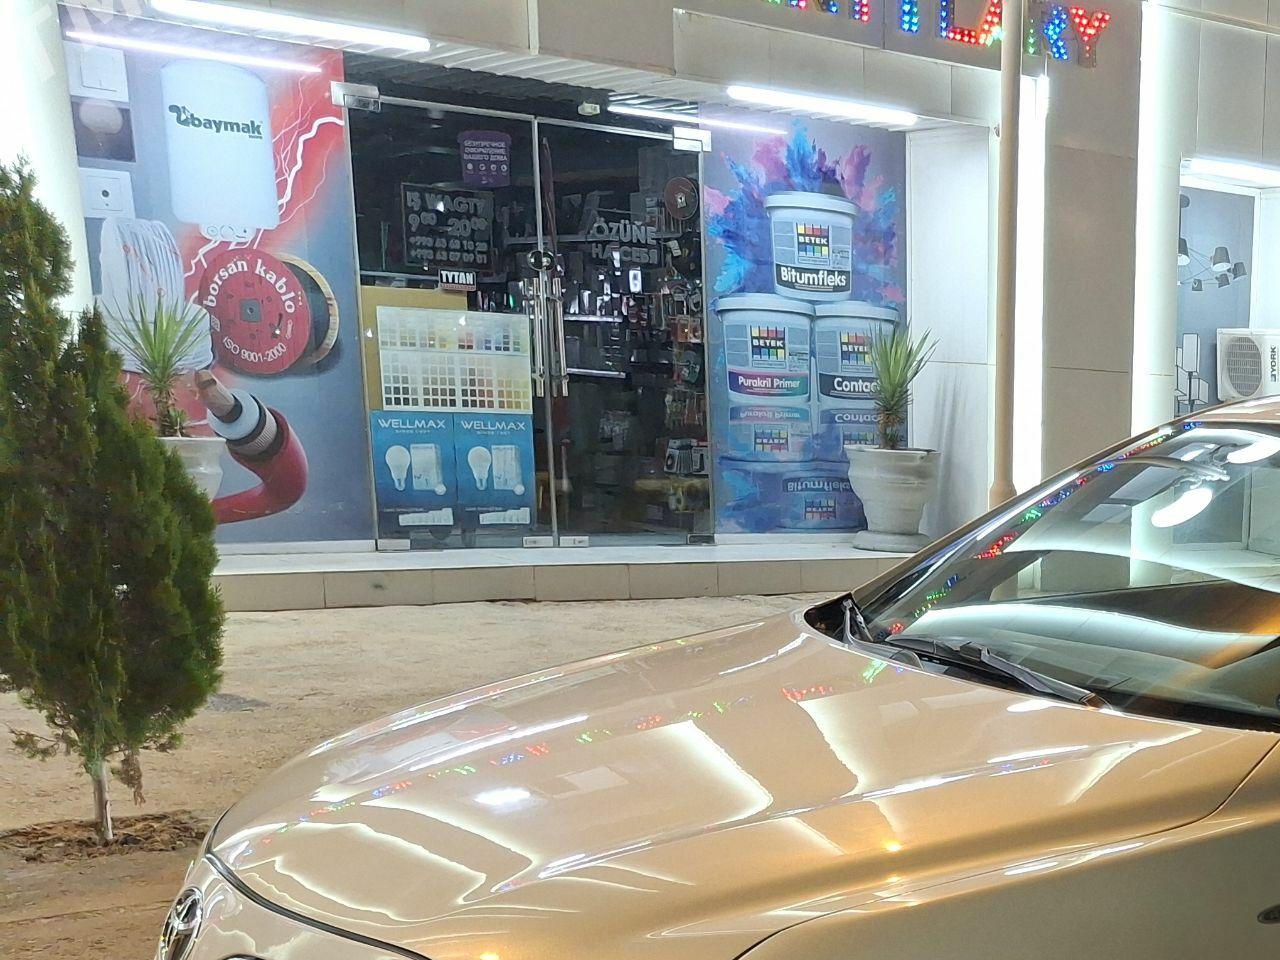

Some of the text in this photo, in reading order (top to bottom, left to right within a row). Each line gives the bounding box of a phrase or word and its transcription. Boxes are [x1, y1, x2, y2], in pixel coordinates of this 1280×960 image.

[190, 112, 262, 135] baymak
[798, 236, 828, 244] BETEK
[440, 270, 474, 285] TYTAN
[780, 266, 846, 286] Bitumfleks
[203, 259, 295, 313] borsan kablo
[752, 338, 784, 347] BETEK
[841, 344, 868, 352] BETE
[1269, 346, 1277, 374] YORK
[738, 375, 801, 388] Purakril Primer
[377, 418, 446, 429] WELLMAX
[460, 420, 526, 431] WELLMAX
